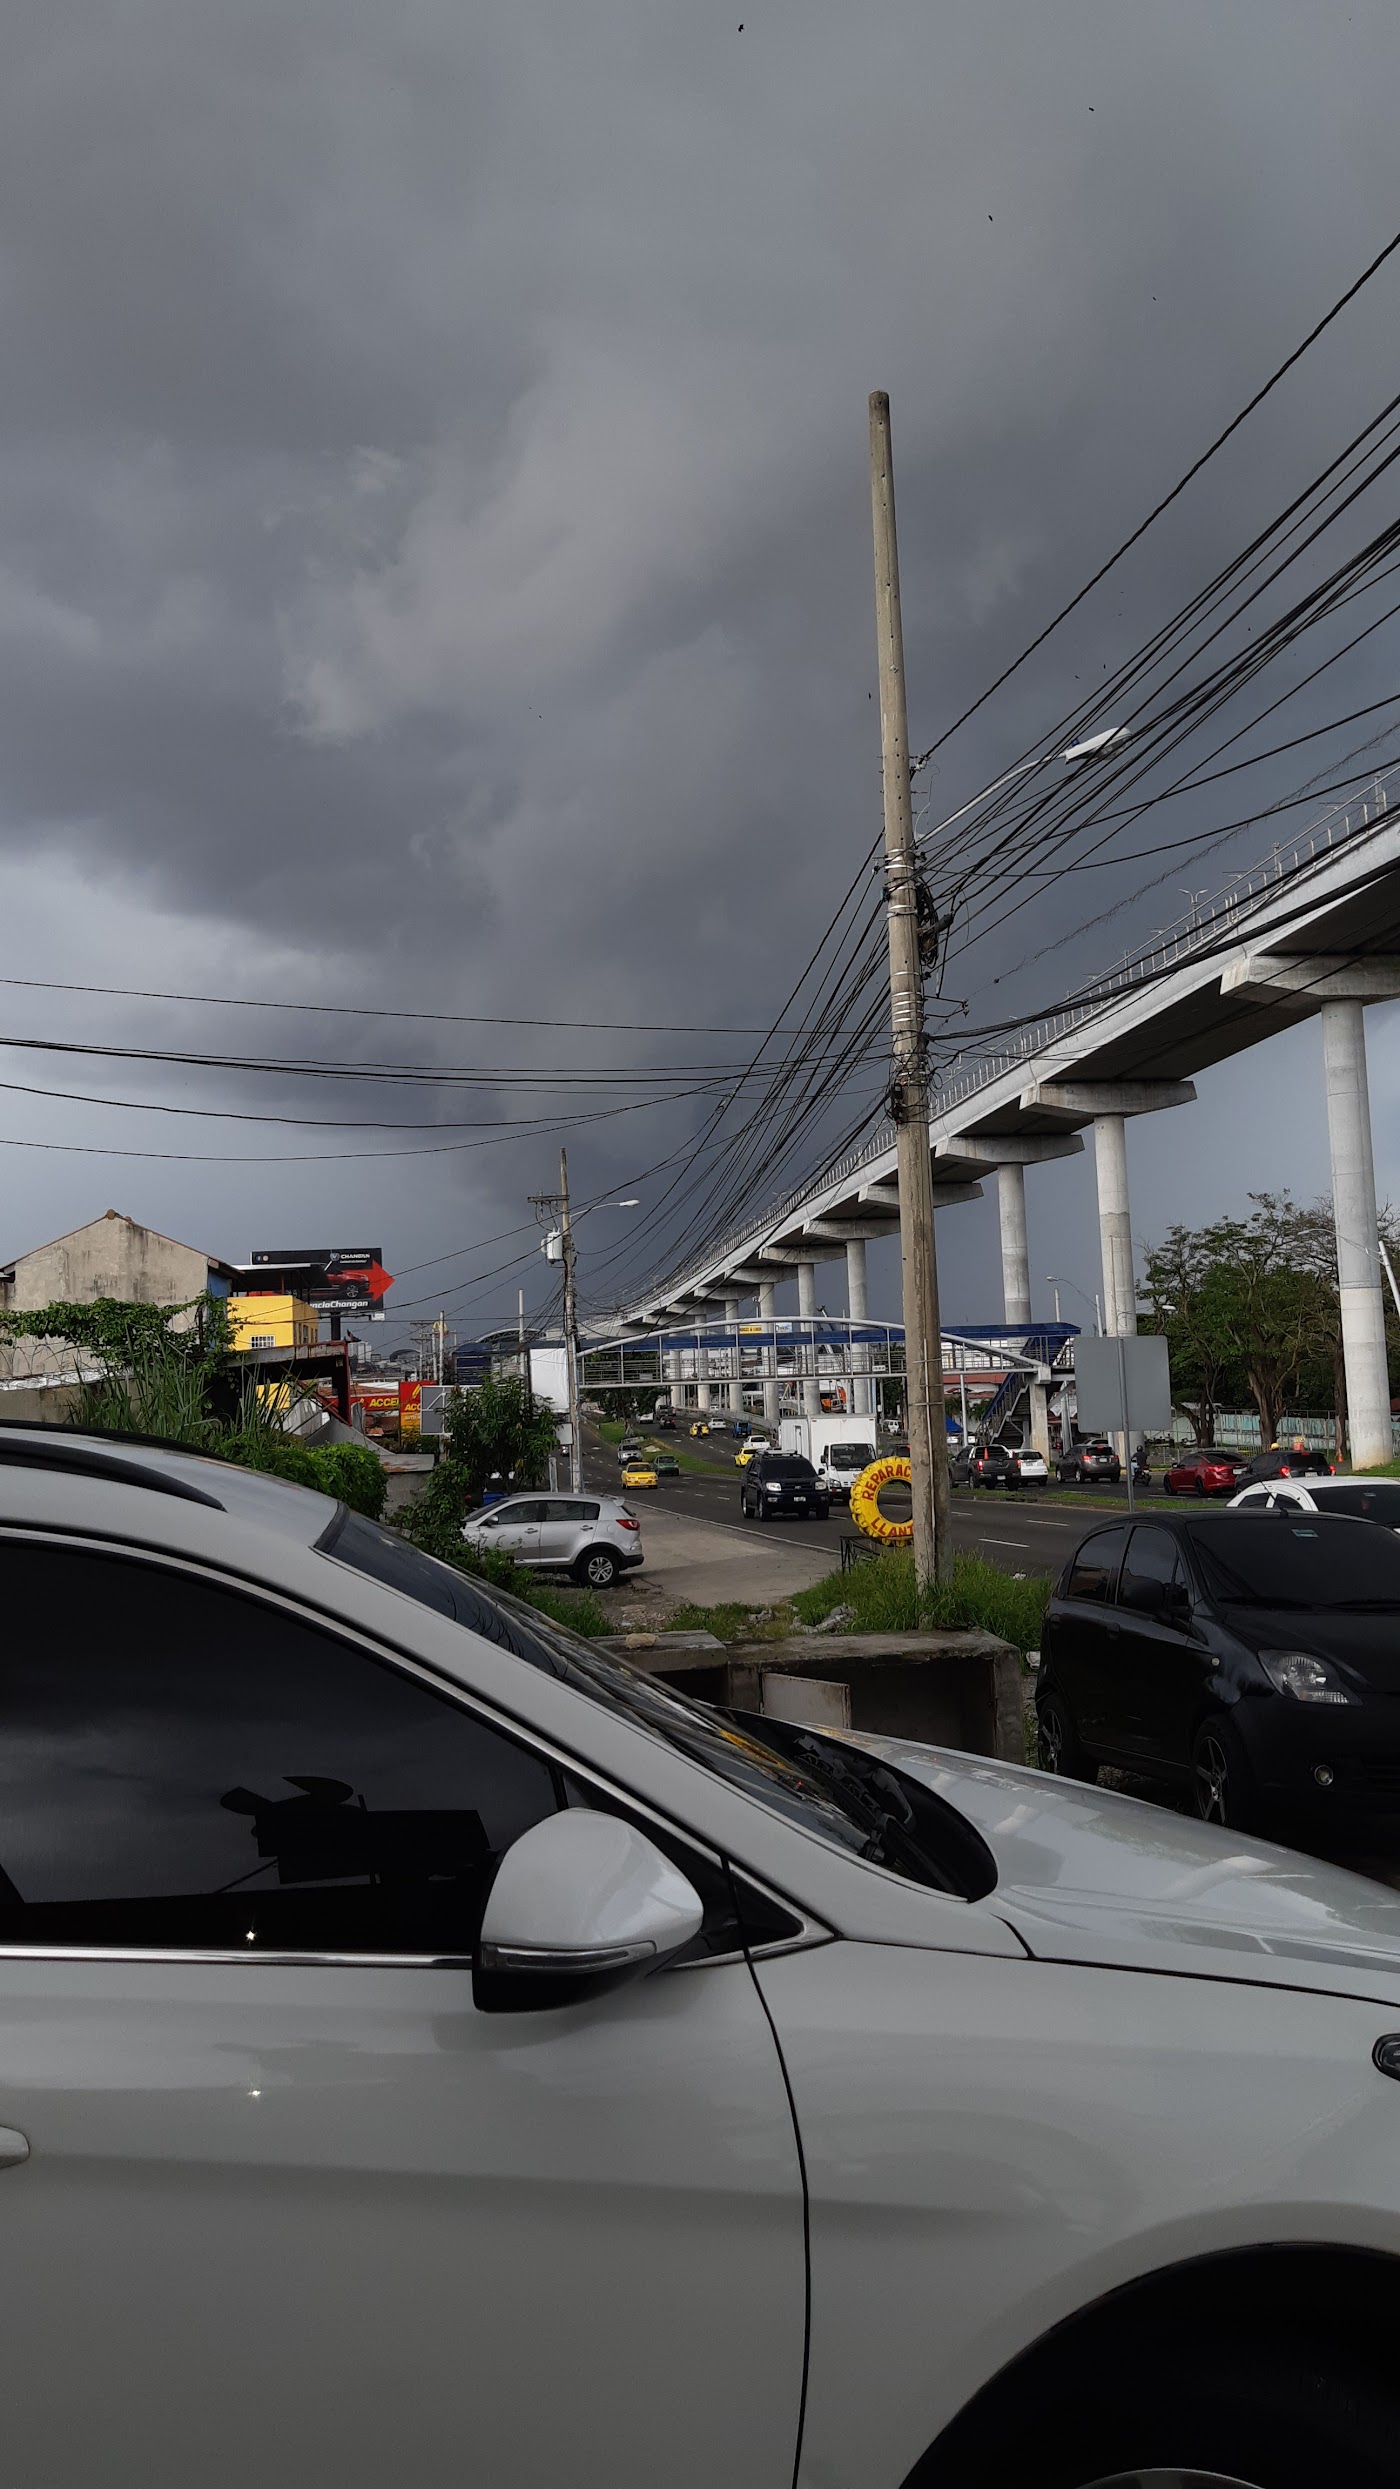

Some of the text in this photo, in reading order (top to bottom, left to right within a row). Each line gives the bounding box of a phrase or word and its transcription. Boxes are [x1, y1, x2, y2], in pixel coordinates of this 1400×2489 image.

[404, 1403, 421, 1411] ACC
[862, 1464, 911, 1501] REPARAC
[871, 1517, 913, 1536] LLANT
